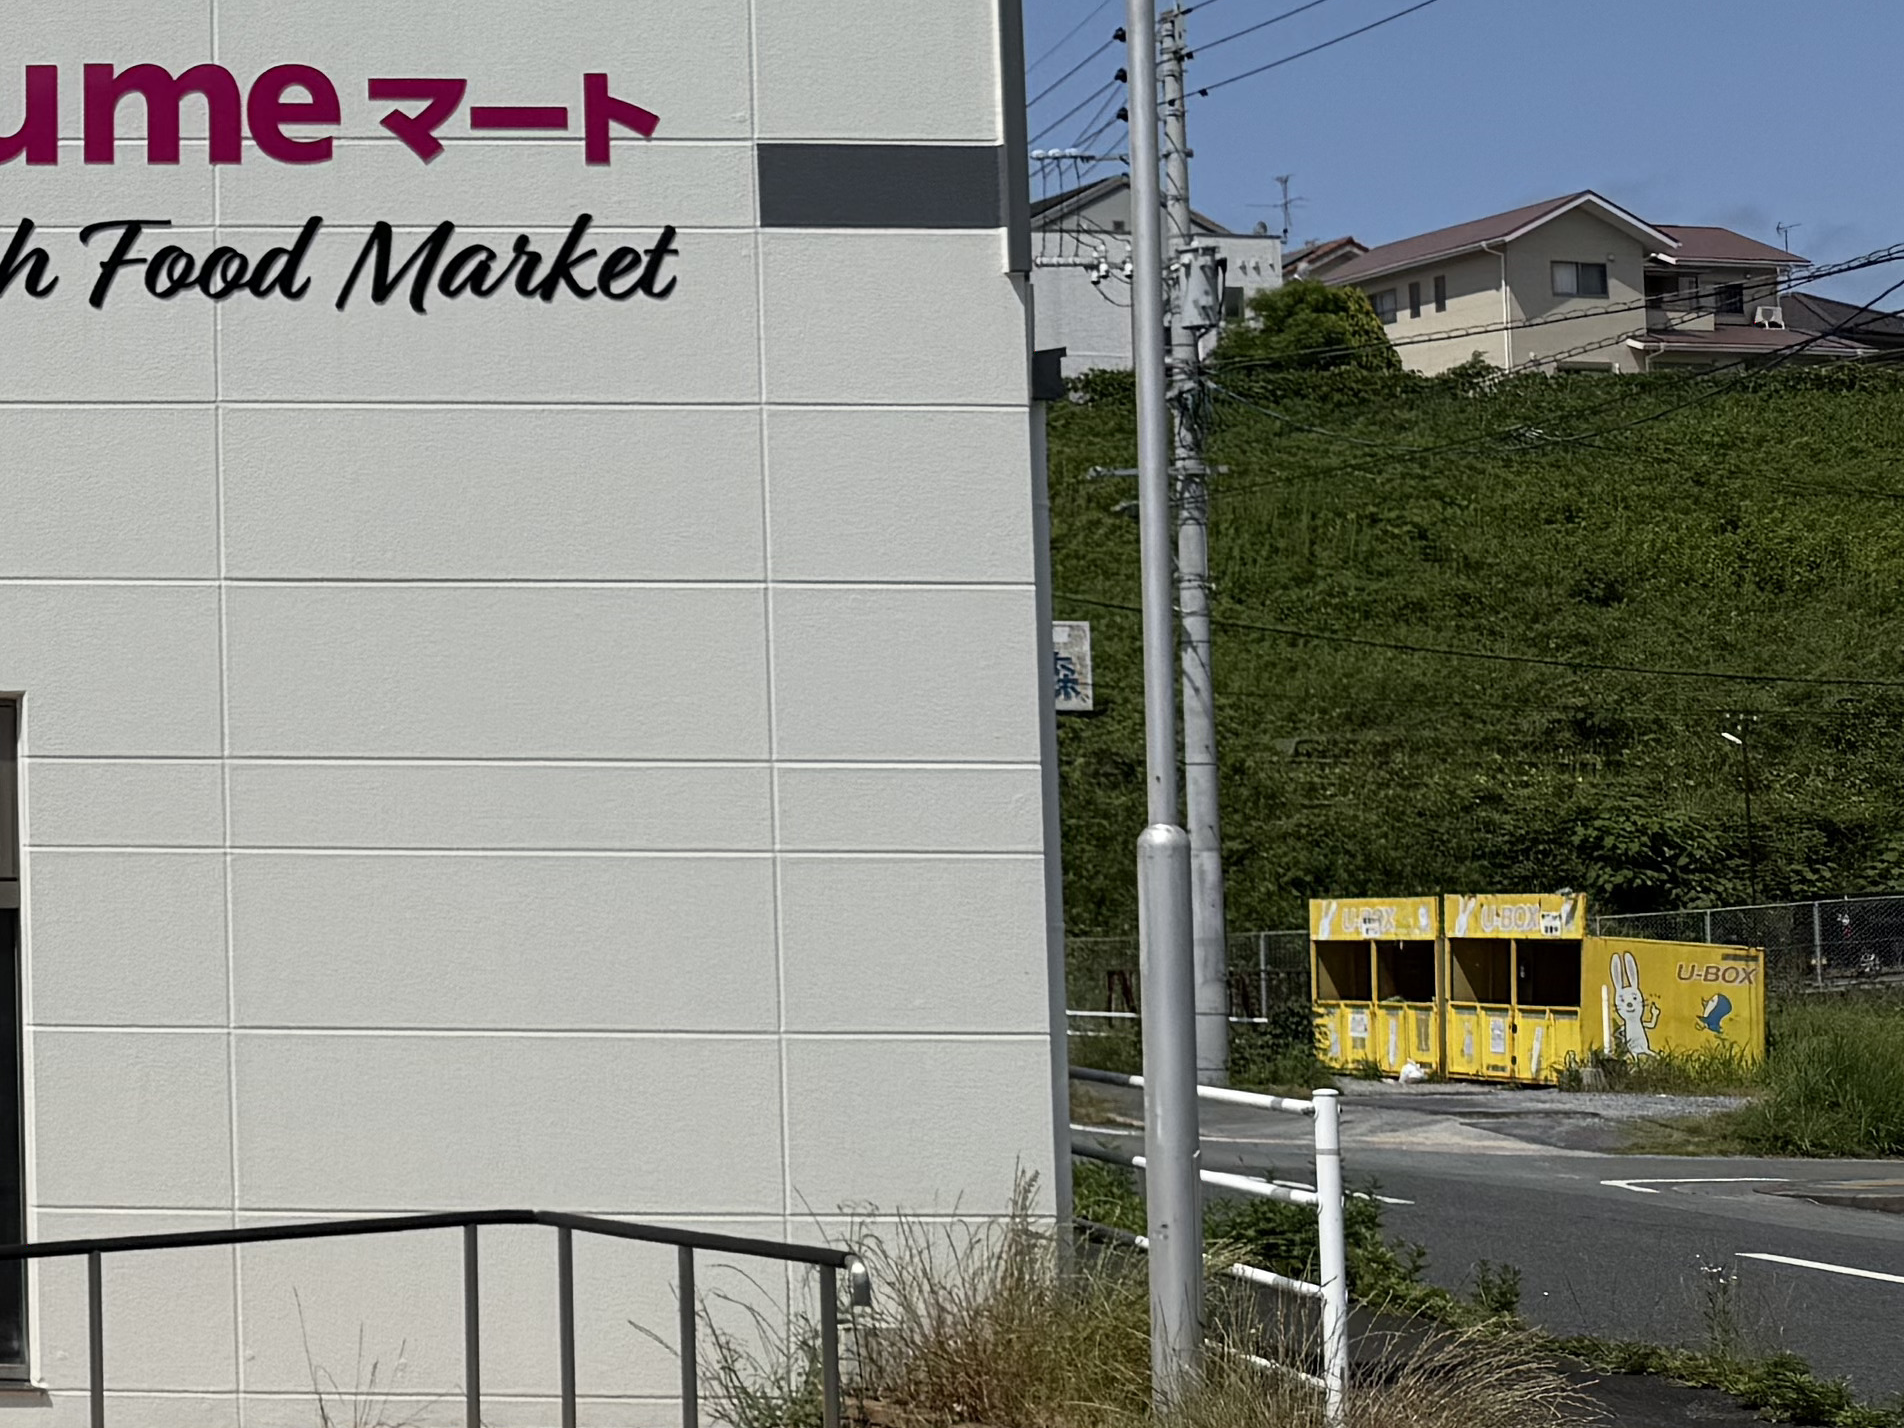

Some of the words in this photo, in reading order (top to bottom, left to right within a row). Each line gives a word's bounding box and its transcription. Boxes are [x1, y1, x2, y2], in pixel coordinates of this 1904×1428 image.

[78, 214, 324, 309] Food
[334, 212, 680, 314] Market
[1481, 903, 1541, 932] U-BOX
[1676, 962, 1757, 985] U-BOX
